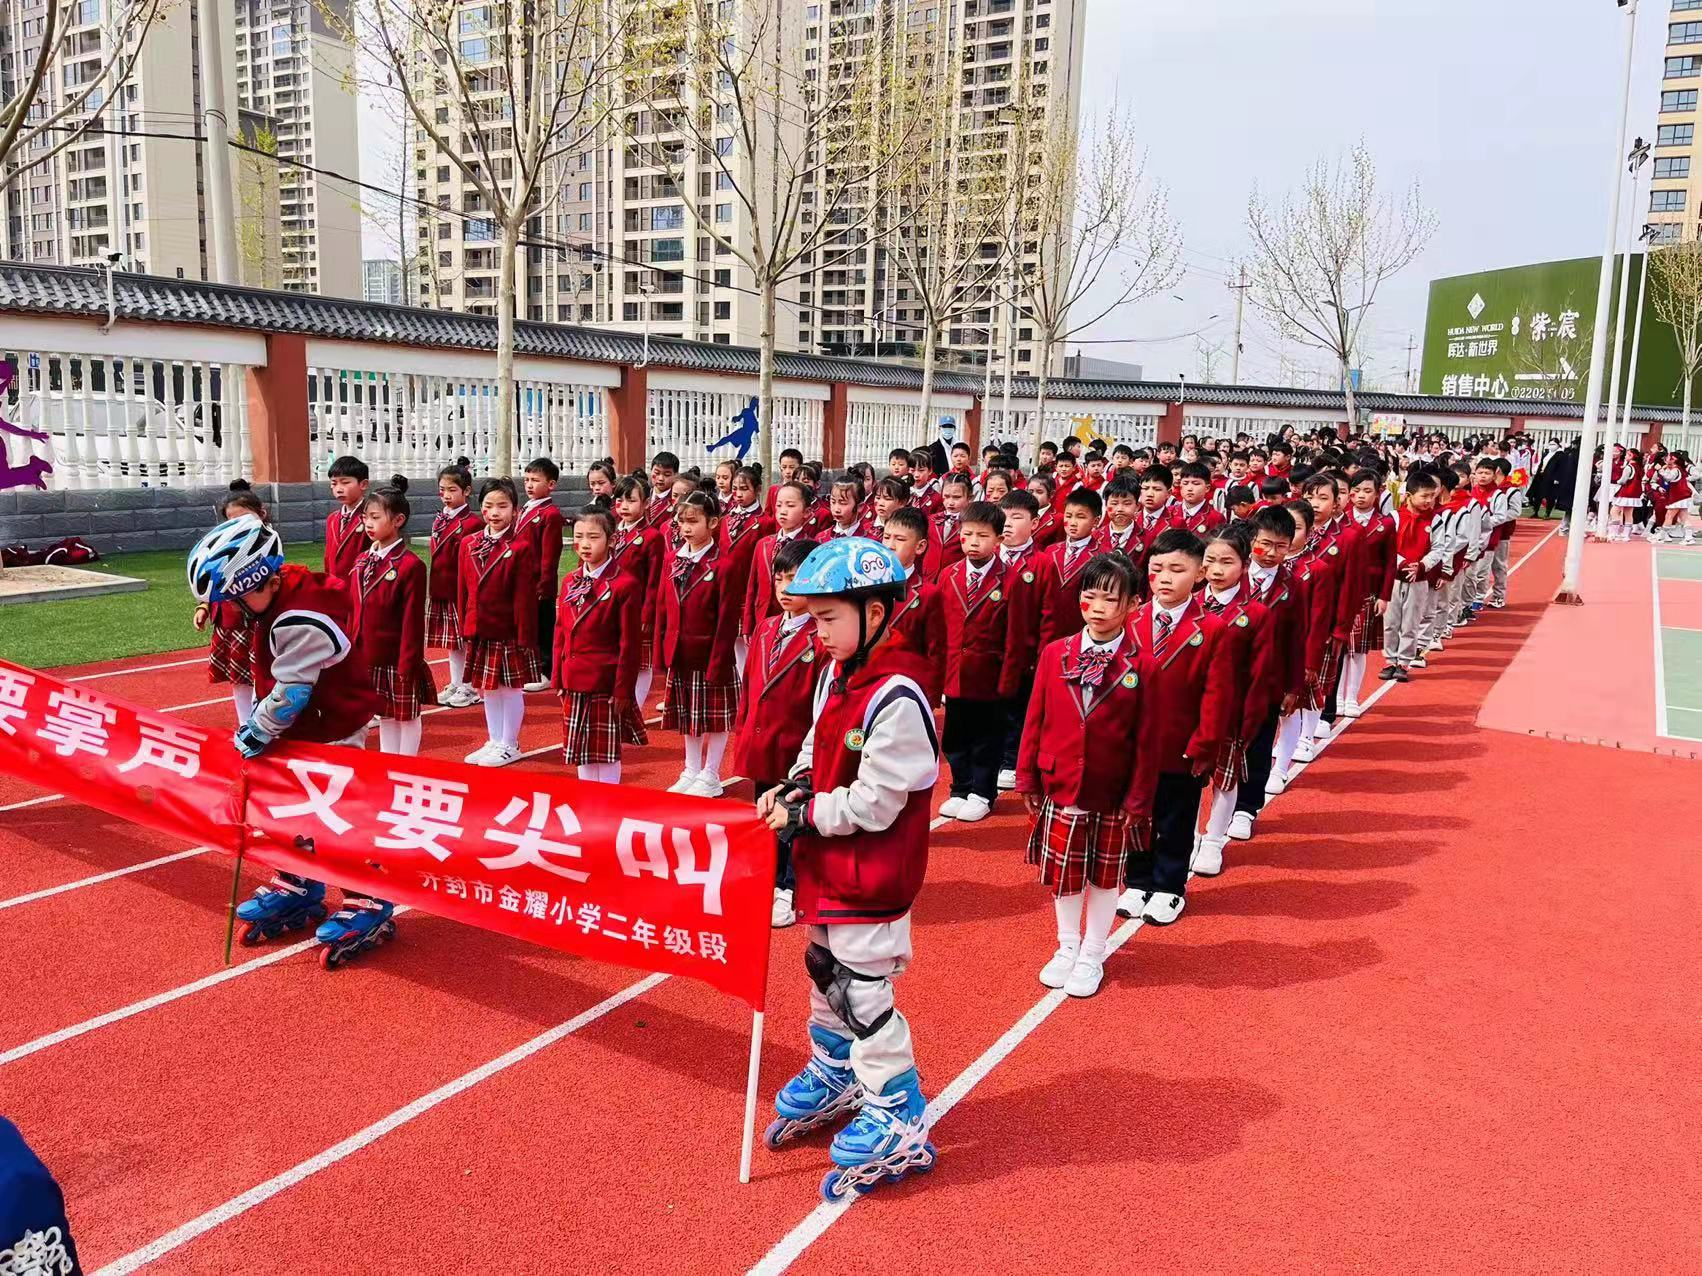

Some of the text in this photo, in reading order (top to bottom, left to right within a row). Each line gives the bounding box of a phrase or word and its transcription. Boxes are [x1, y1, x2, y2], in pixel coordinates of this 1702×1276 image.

[1441, 373, 1510, 399] 销售中心
[228, 565, 269, 595] W200
[267, 759, 729, 915] 又要尖叫
